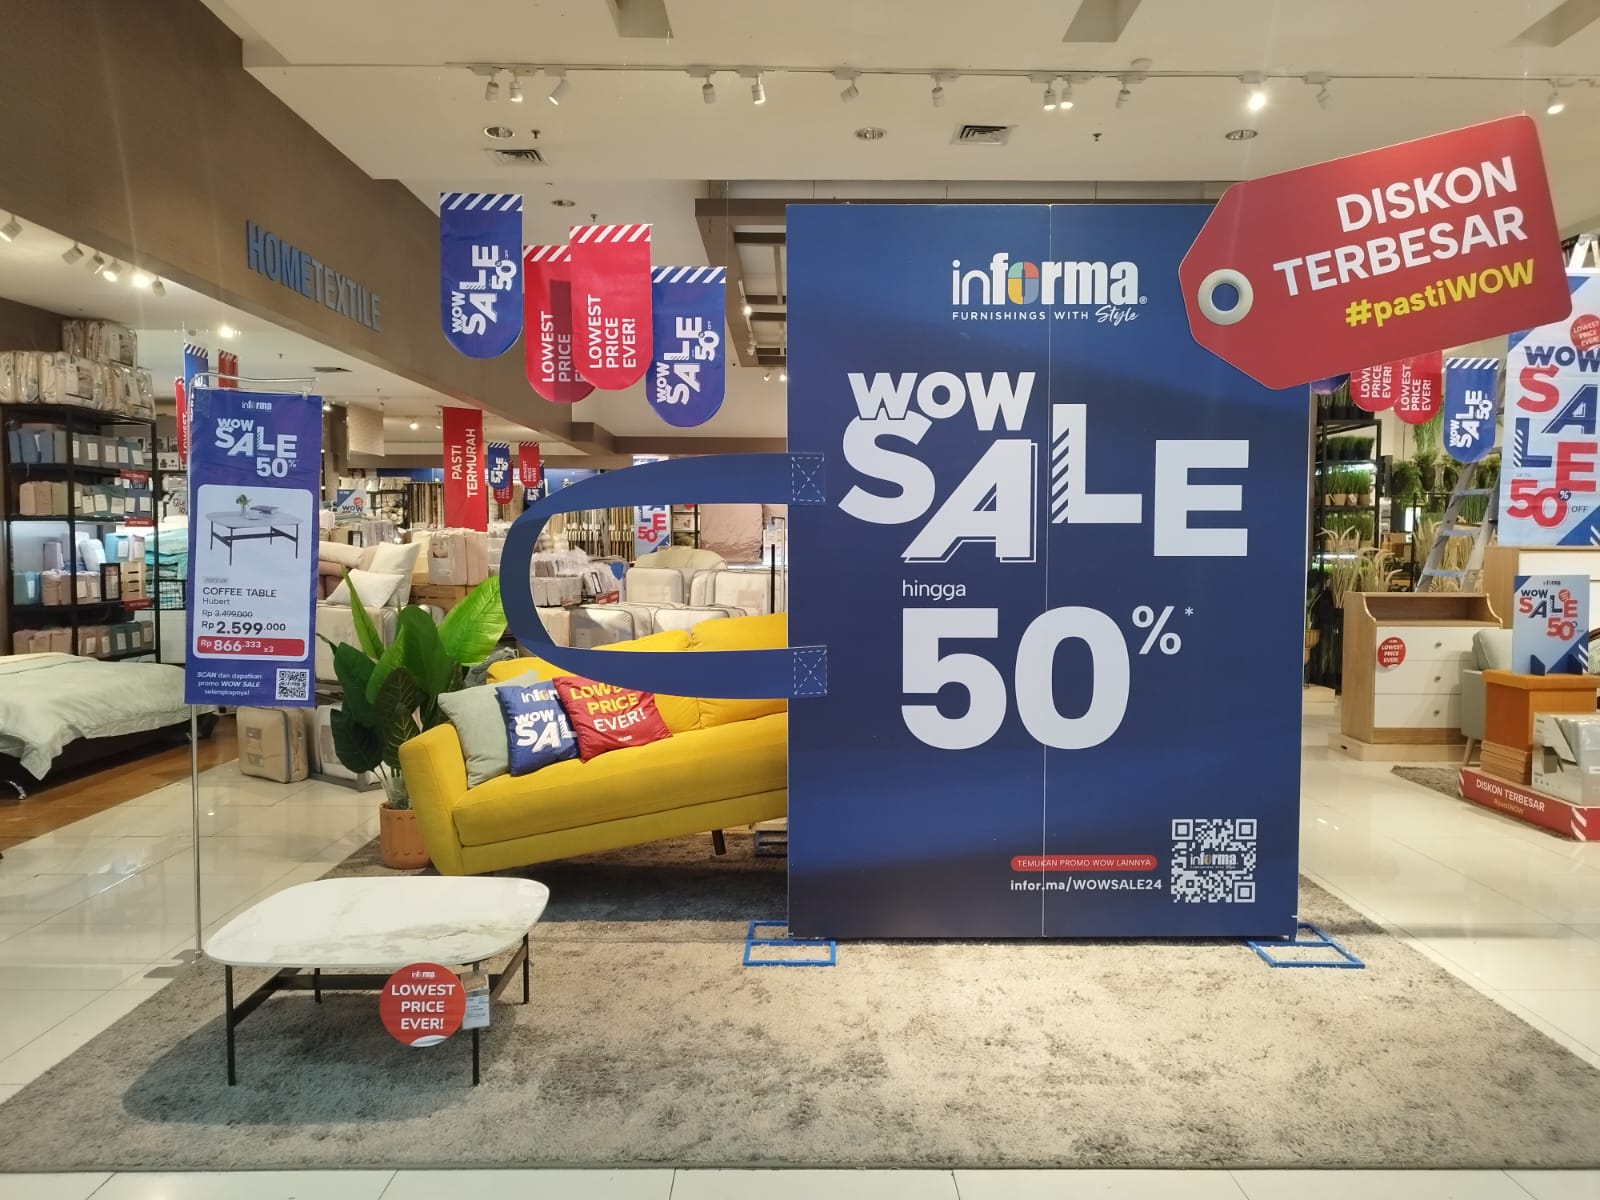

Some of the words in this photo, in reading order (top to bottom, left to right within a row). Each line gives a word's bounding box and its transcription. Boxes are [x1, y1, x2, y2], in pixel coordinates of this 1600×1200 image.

[1336, 155, 1518, 233] DISKON
[1272, 205, 1529, 297] TERBESAR
[459, 244, 499, 336] SALE
[952, 252, 1139, 305] informa
[1344, 258, 1535, 328] #pastiWOW
[451, 290, 466, 333] WOW
[952, 311, 1046, 321] FURNISHINGS
[1054, 311, 1089, 320] WITH
[1095, 304, 1140, 326] Style
[540, 310, 555, 383] LOWEST
[588, 294, 602, 369] LOWEST
[605, 317, 620, 369] PRICE
[622, 318, 636, 368] EVER!
[558, 333, 571, 383] PRICE
[663, 316, 702, 406] SALE
[1525, 345, 1600, 373] WOW
[656, 361, 670, 404] WOW
[1371, 364, 1382, 398] PRICE
[1382, 366, 1392, 399] EVER!
[1401, 364, 1412, 411] LOWEST
[1411, 379, 1422, 411] PRICE
[1422, 379, 1432, 411] EVER!
[847, 371, 1036, 431] WOW
[217, 417, 254, 432] WOW
[1449, 419, 1460, 447] WOW
[1456, 389, 1483, 449] SALE
[214, 426, 297, 458] SALE
[256, 457, 296, 478] 50%
[451, 445, 463, 480] PASTI
[465, 428, 479, 499] TERMURAH
[838, 403, 1250, 563] SALE
[1506, 479, 1572, 528] 50%
[1571, 505, 1589, 513] OFF
[202, 586, 242, 596] COFFEE
[246, 589, 277, 598] TABLE
[202, 597, 230, 605] Hubert
[902, 580, 966, 601] hingga
[1519, 594, 1578, 619] SALE
[1520, 589, 1548, 599] WOW
[201, 620, 214, 630] Rp
[216, 620, 286, 635] 2.599.000
[202, 609, 212, 618] Rp
[200, 640, 212, 648] Rp
[213, 639, 261, 651] 866.333
[264, 645, 274, 653] x3
[514, 708, 554, 727] WOW
[586, 692, 639, 716] PRICE
[593, 707, 648, 732] EVER!
[514, 714, 578, 753] SAL
[1475, 778, 1503, 797] DISKON
[1503, 789, 1545, 813] TERBESAR
[1017, 859, 1058, 868] TEMUKAN
[1060, 859, 1090, 867] PROMO
[1092, 859, 1115, 867] WOW
[1116, 859, 1151, 867] LAINNYA
[1010, 876, 1162, 892] infor.ma/WOWSALE24
[391, 984, 456, 996] LOWEST
[401, 1001, 445, 1013] PRICE
[400, 1017, 444, 1030] EVER!
